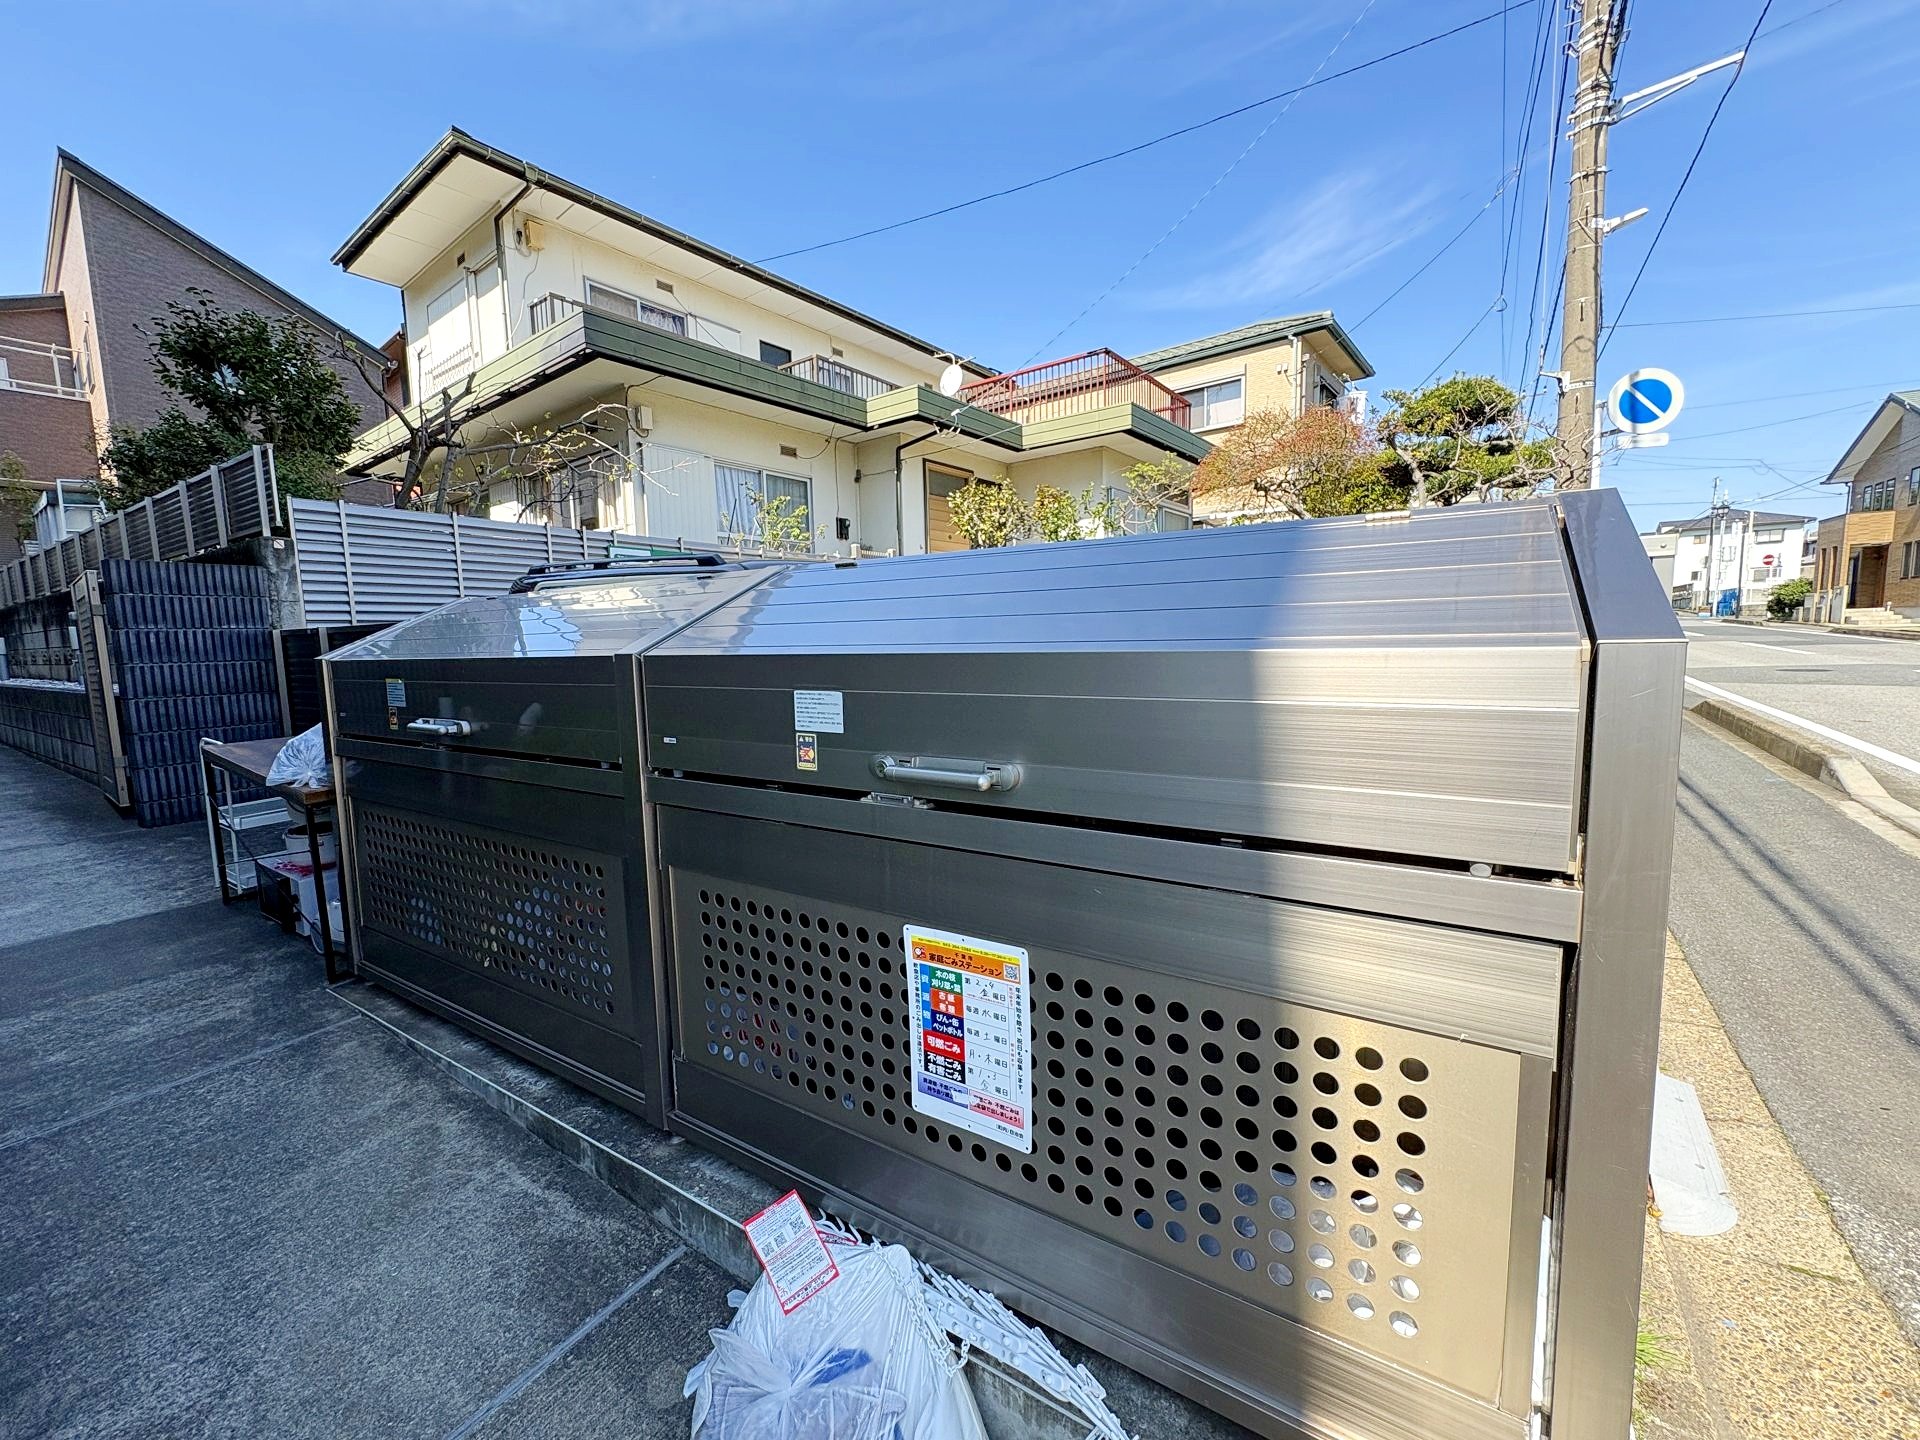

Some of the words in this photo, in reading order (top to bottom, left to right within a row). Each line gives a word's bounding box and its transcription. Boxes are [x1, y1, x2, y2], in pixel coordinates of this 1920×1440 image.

[928, 952, 1002, 977] 家庭ごみステーション
[927, 1035, 961, 1054] 可燃ごみ
[927, 1052, 962, 1071] 不燃ごみ
